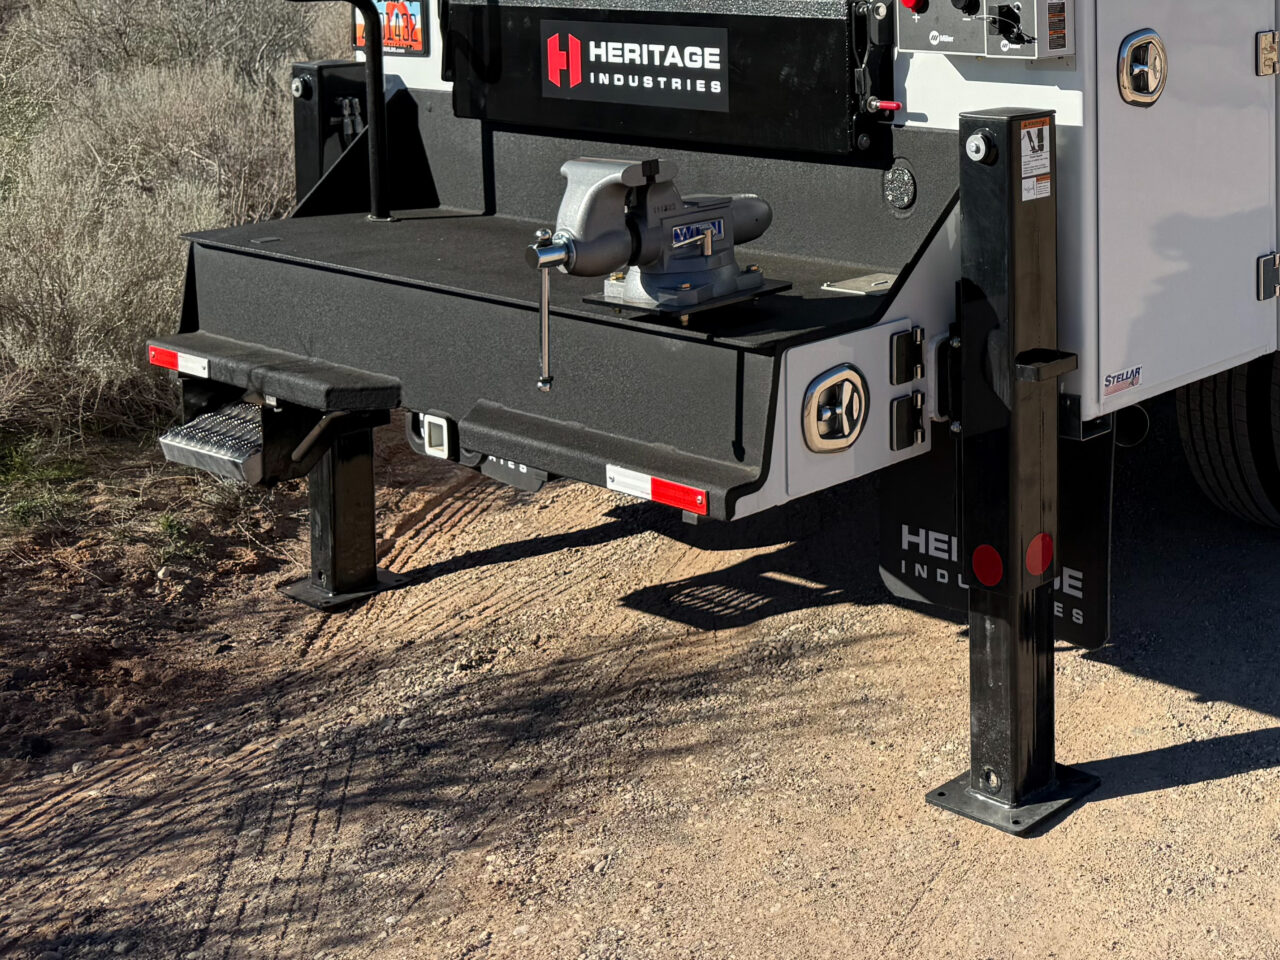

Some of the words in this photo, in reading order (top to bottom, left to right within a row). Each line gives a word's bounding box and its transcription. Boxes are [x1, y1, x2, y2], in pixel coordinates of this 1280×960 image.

[589, 41, 721, 70] HERITAGE
[589, 72, 721, 93] INDUSTRIES
[1104, 367, 1142, 388] STELLAR
